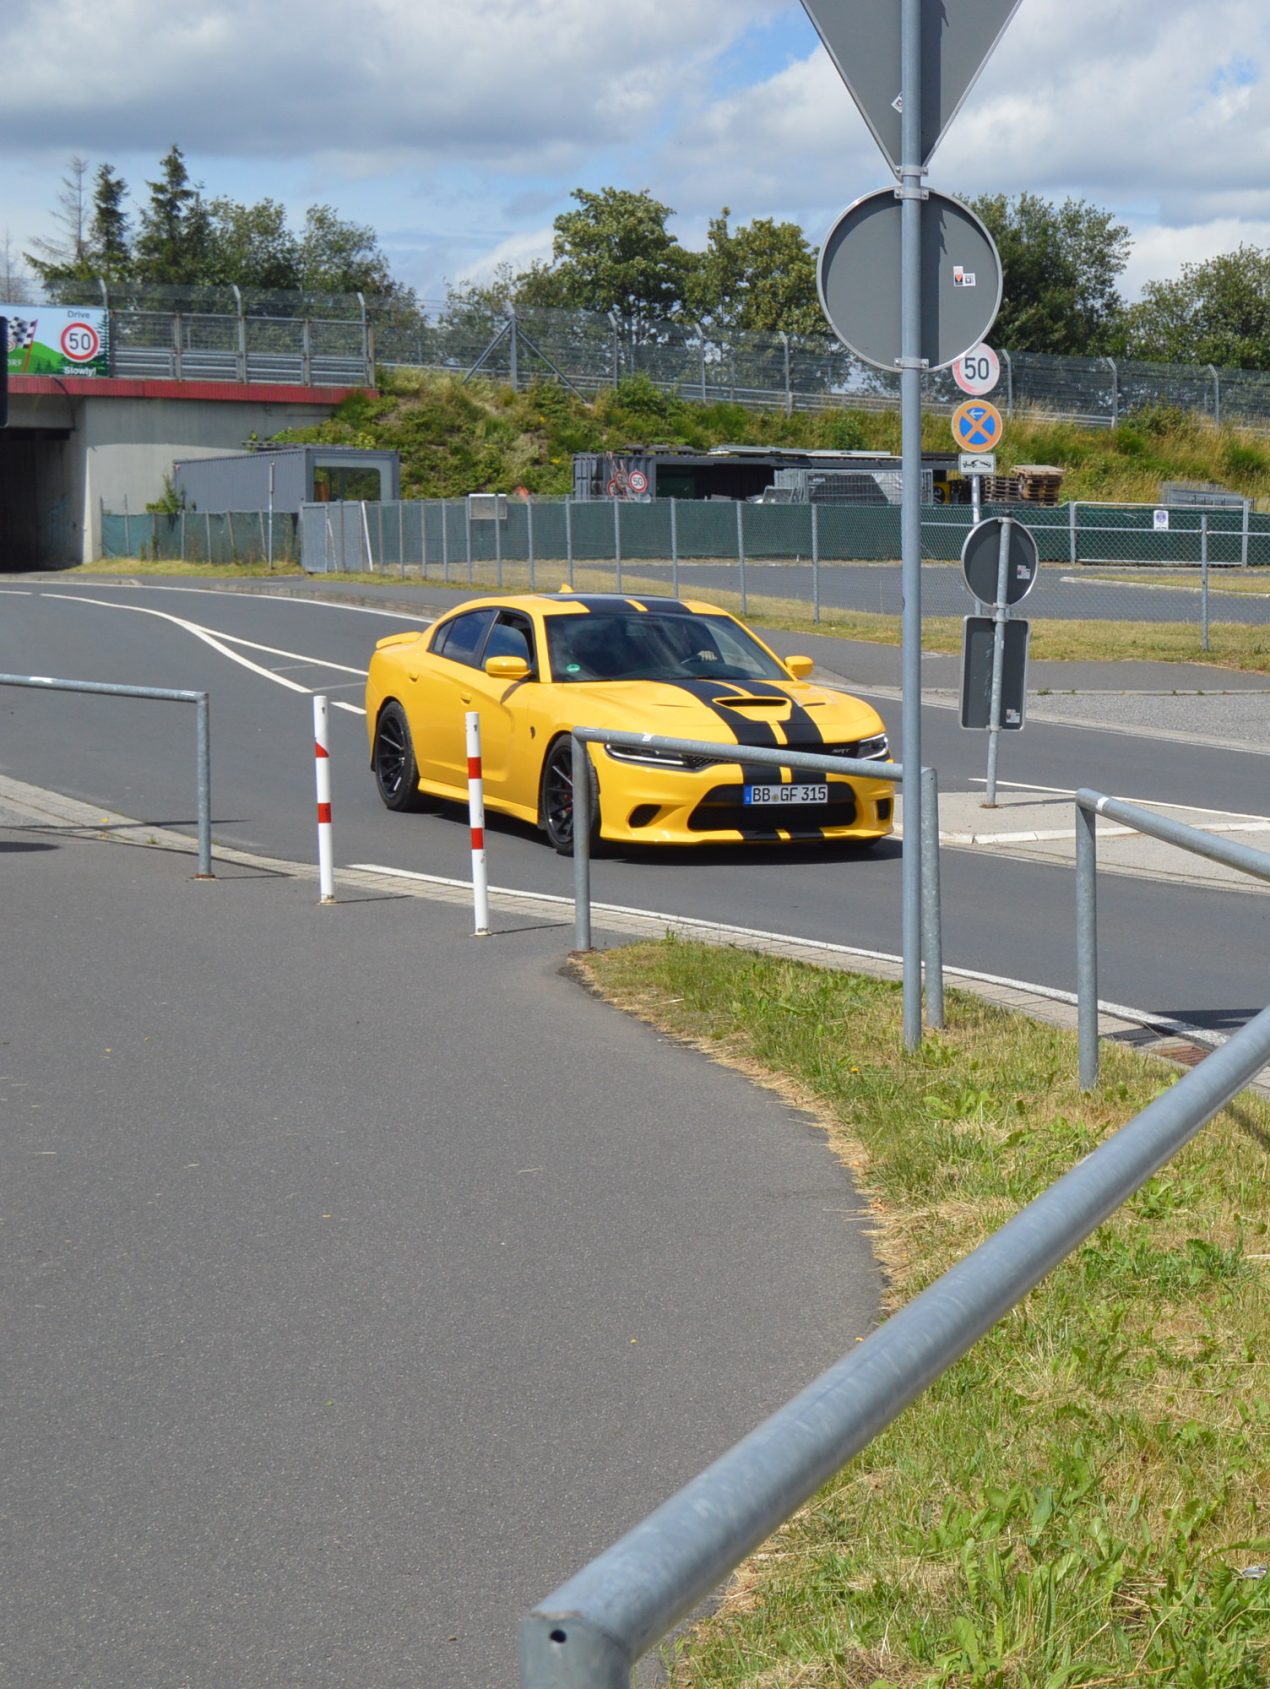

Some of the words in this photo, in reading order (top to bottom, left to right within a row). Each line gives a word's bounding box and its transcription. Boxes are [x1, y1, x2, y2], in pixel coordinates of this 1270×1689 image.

[67, 310, 91, 319] Drive
[69, 333, 91, 350] 50
[64, 367, 97, 376] Slowly!
[964, 357, 990, 380] 50
[632, 476, 643, 486] 50
[752, 787, 771, 802] BB
[780, 786, 798, 801] GF
[801, 786, 826, 800] 315
